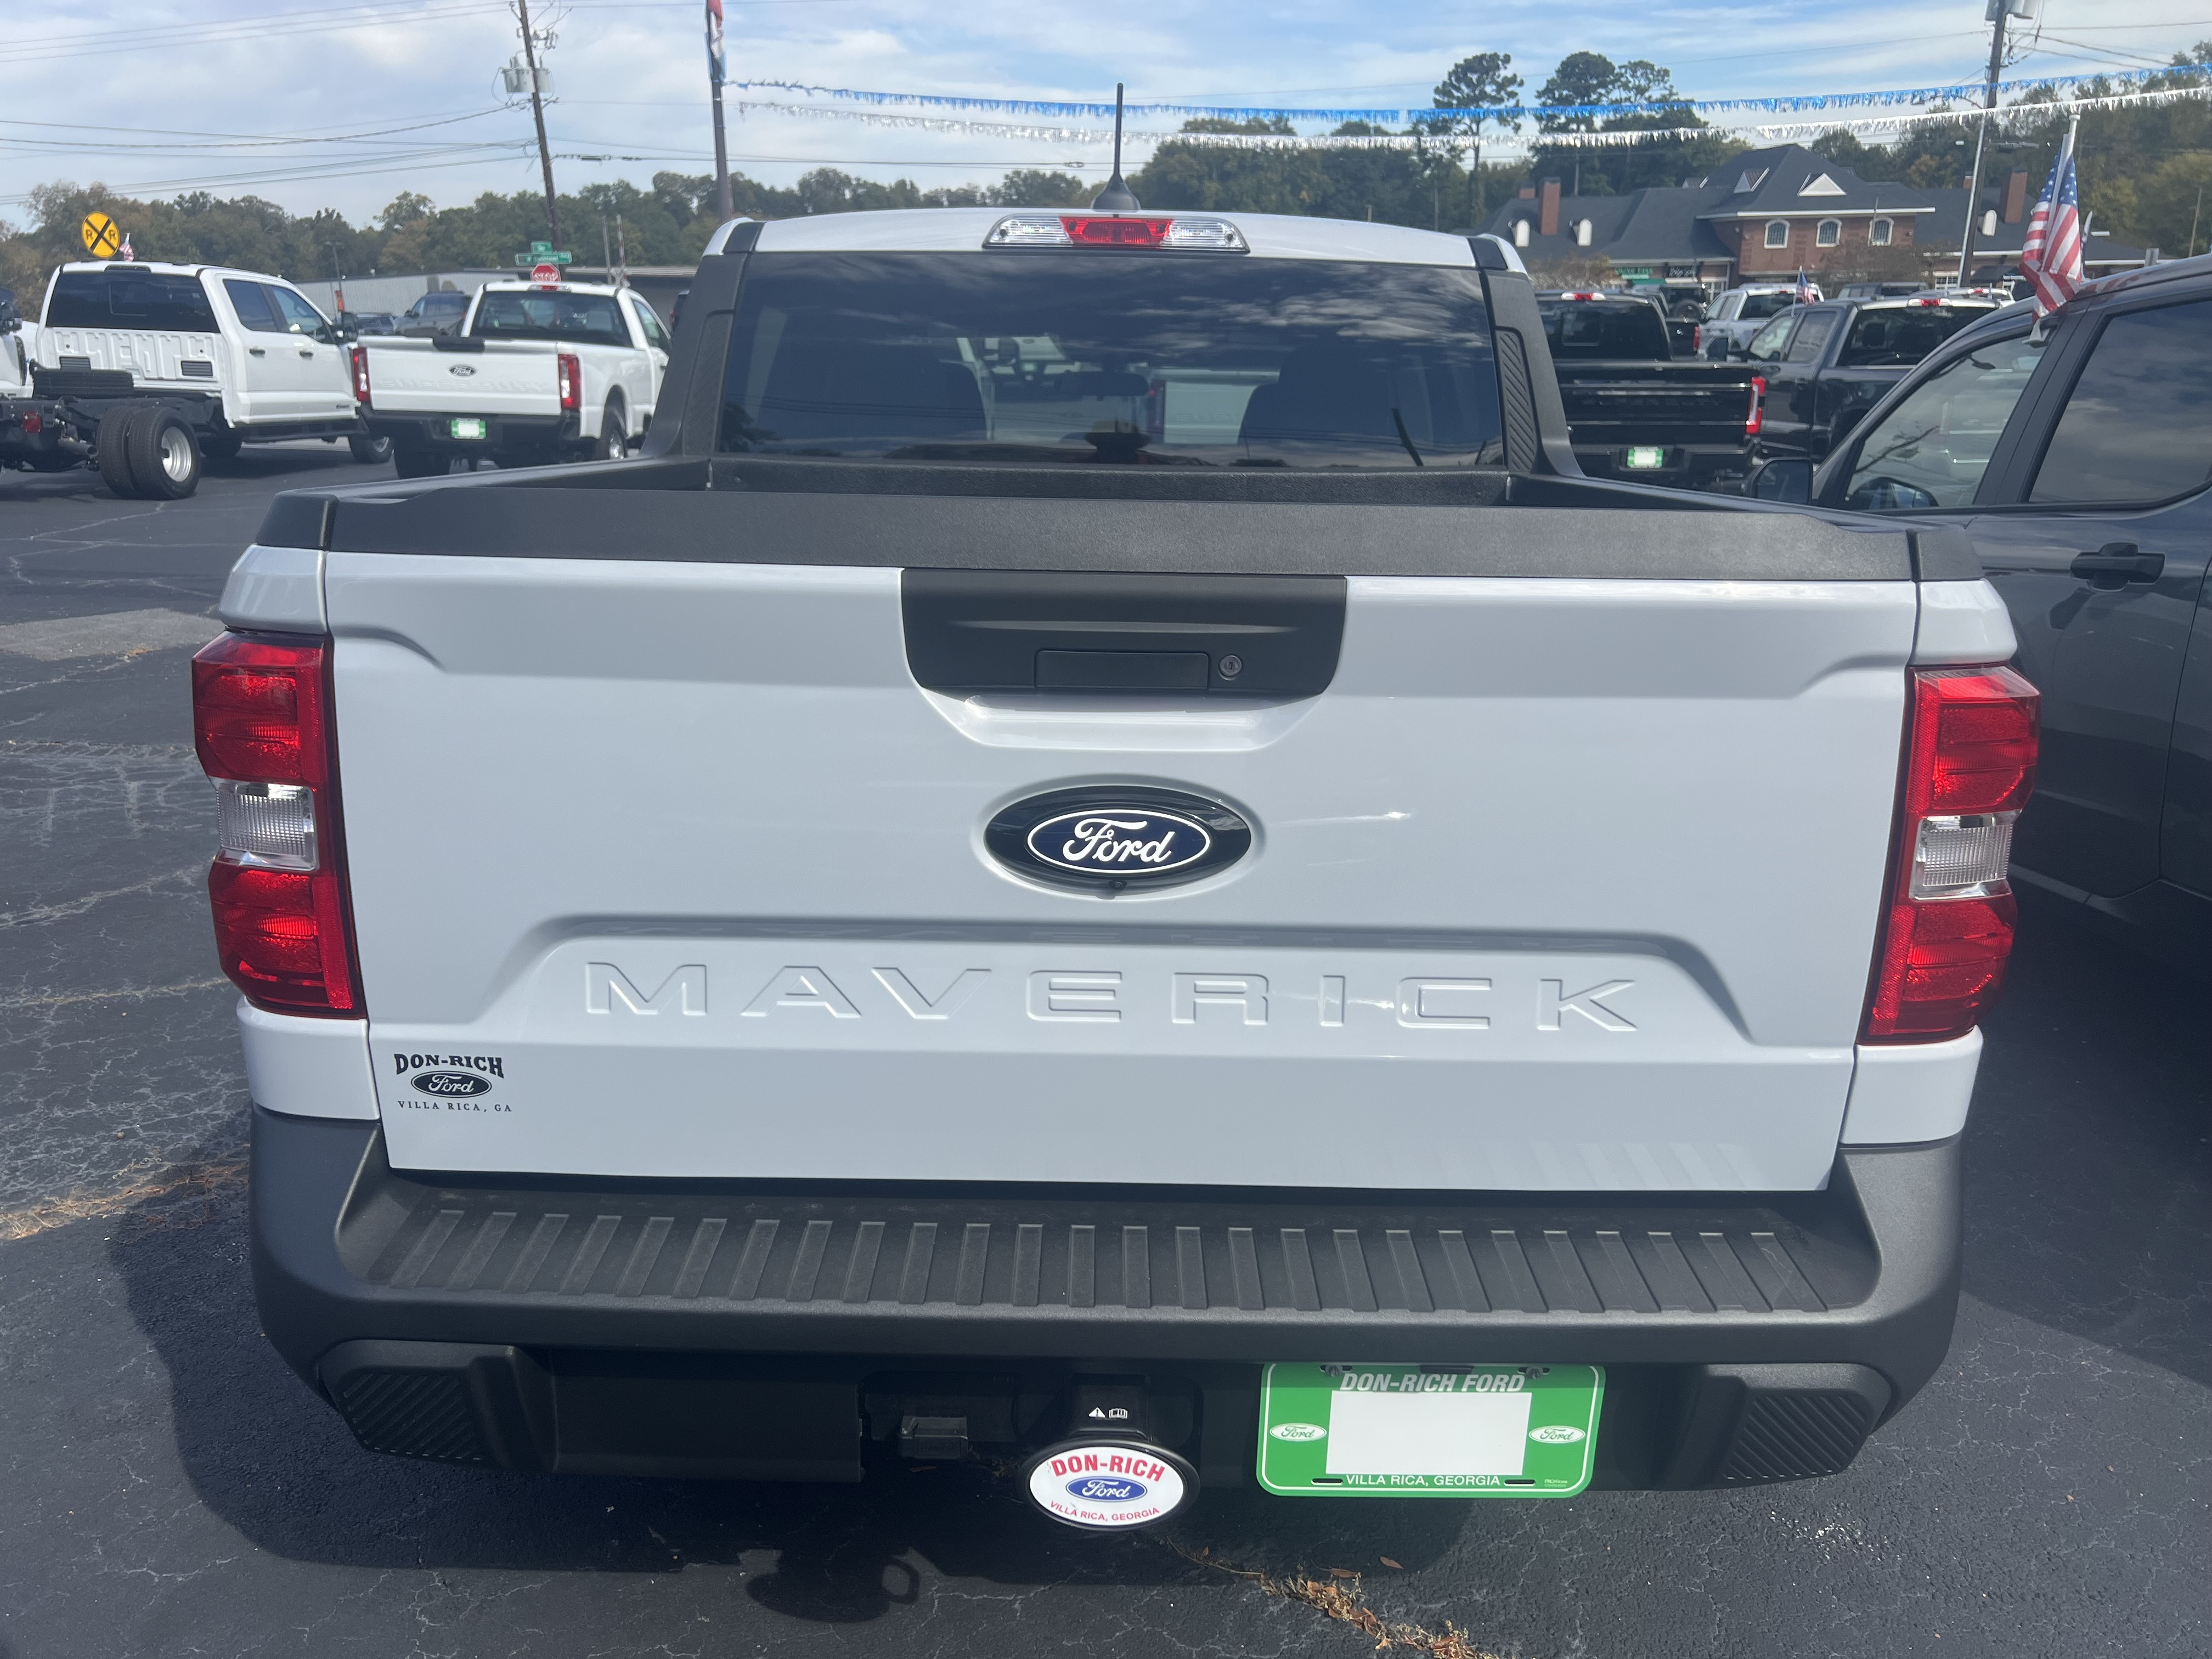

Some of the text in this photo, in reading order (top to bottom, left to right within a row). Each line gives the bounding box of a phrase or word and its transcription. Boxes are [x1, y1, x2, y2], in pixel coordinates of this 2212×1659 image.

[86, 229, 117, 241] R R
[533, 272, 558, 283] STOP
[1063, 818, 1176, 862] Ford
[586, 962, 1637, 1031] MAVERICK
[394, 1053, 504, 1079] DON-RICH
[428, 1074, 474, 1092] Ford
[398, 1101, 512, 1113] VILLA RICA, GA
[1340, 1373, 1526, 1392] DON-RICH FORD
[1281, 1425, 1315, 1438] Ford
[1540, 1428, 1574, 1440] Ford
[1051, 1454, 1165, 1482] DON-RICH
[1081, 1480, 1131, 1498] Ford
[1346, 1474, 1500, 1487] VILLA RICA, GEORGIA
[1050, 1500, 1160, 1522] VILLA RICA, GEORGIA
